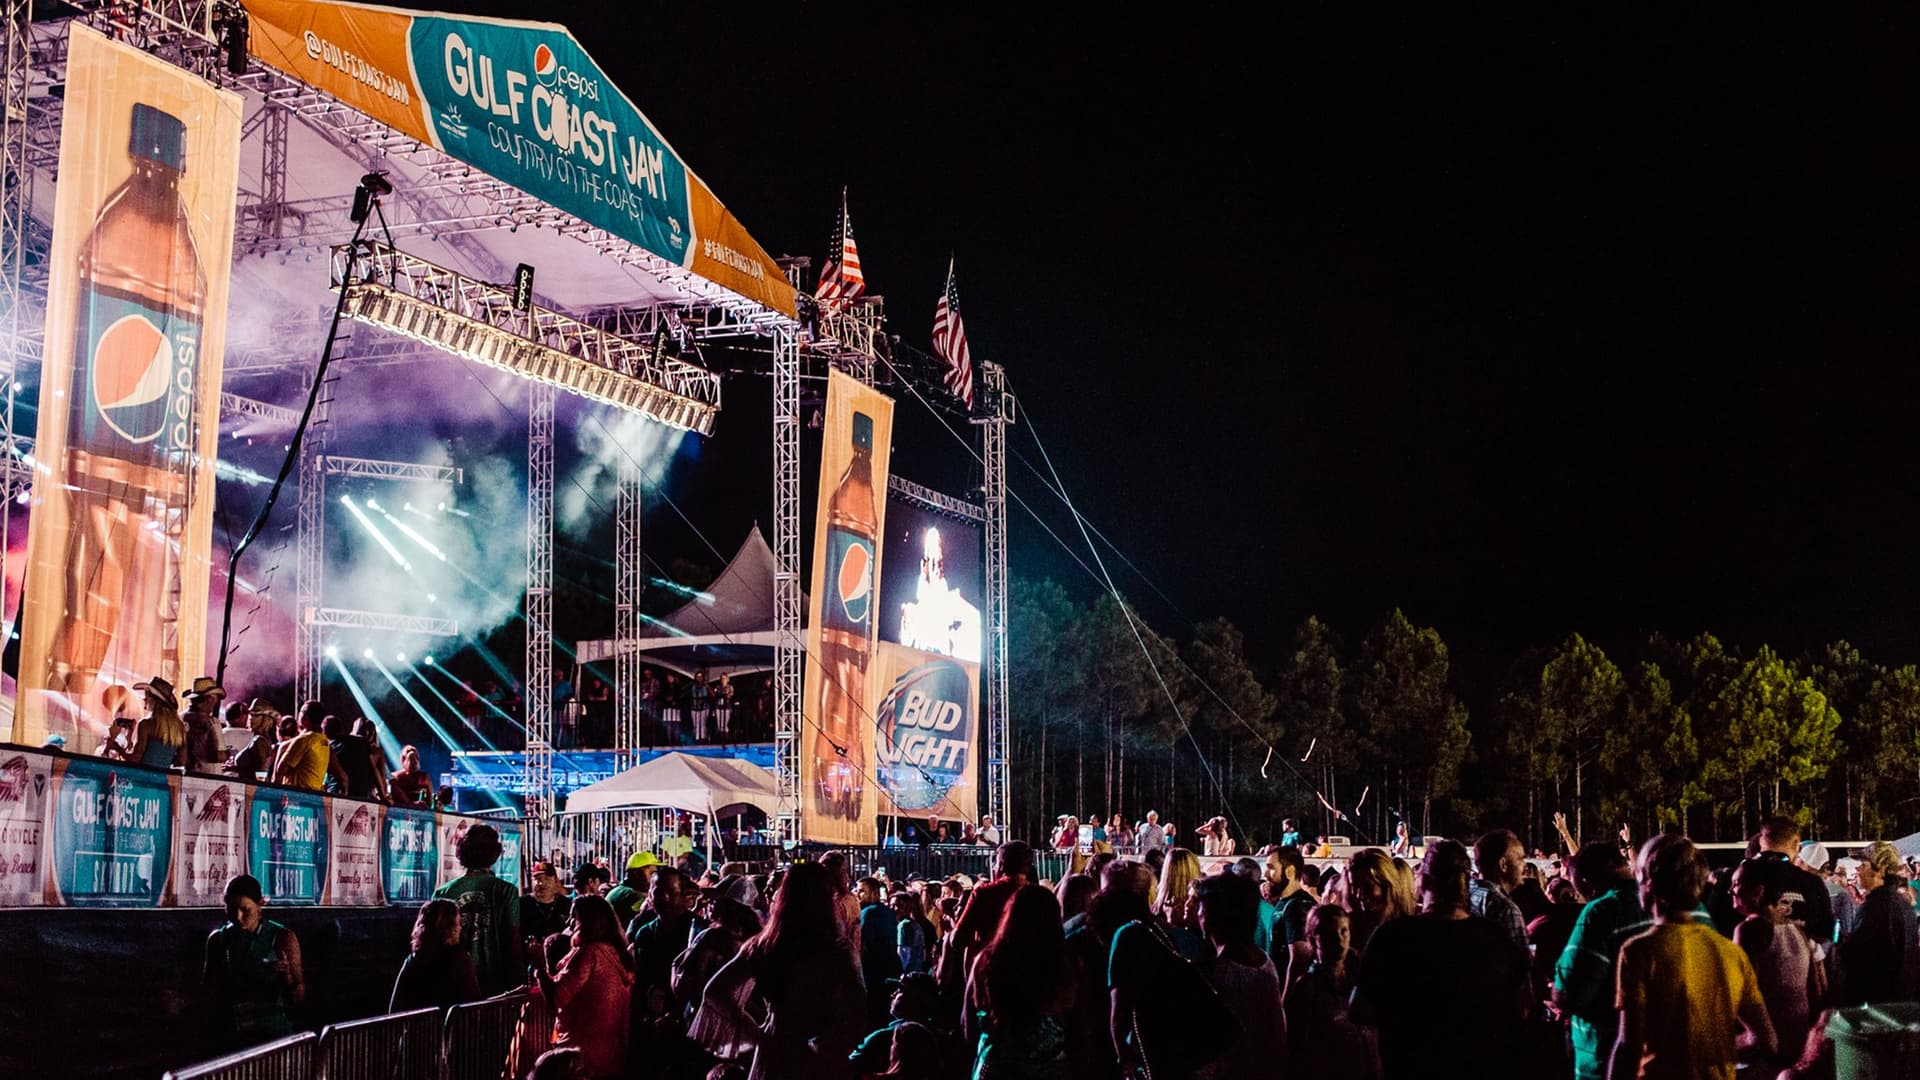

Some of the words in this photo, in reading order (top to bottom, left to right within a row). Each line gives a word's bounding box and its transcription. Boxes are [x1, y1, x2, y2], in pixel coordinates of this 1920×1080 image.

[304, 30, 409, 106] @GULFCOASTJAM
[557, 65, 600, 102] pepsi
[444, 32, 528, 125] GULF
[531, 83, 617, 175] COAST
[622, 136, 667, 201] JAM
[577, 165, 602, 203] THE
[604, 179, 644, 221] COAST
[704, 237, 764, 281] #GULFCOASTJAM
[174, 334, 197, 450] pepsi
[898, 689, 962, 732] BUD
[878, 733, 969, 770] LIGHT
[73, 788, 105, 825] GULF
[105, 793, 140, 829] COAST
[139, 799, 160, 830] JAM
[259, 809, 282, 840] GULF
